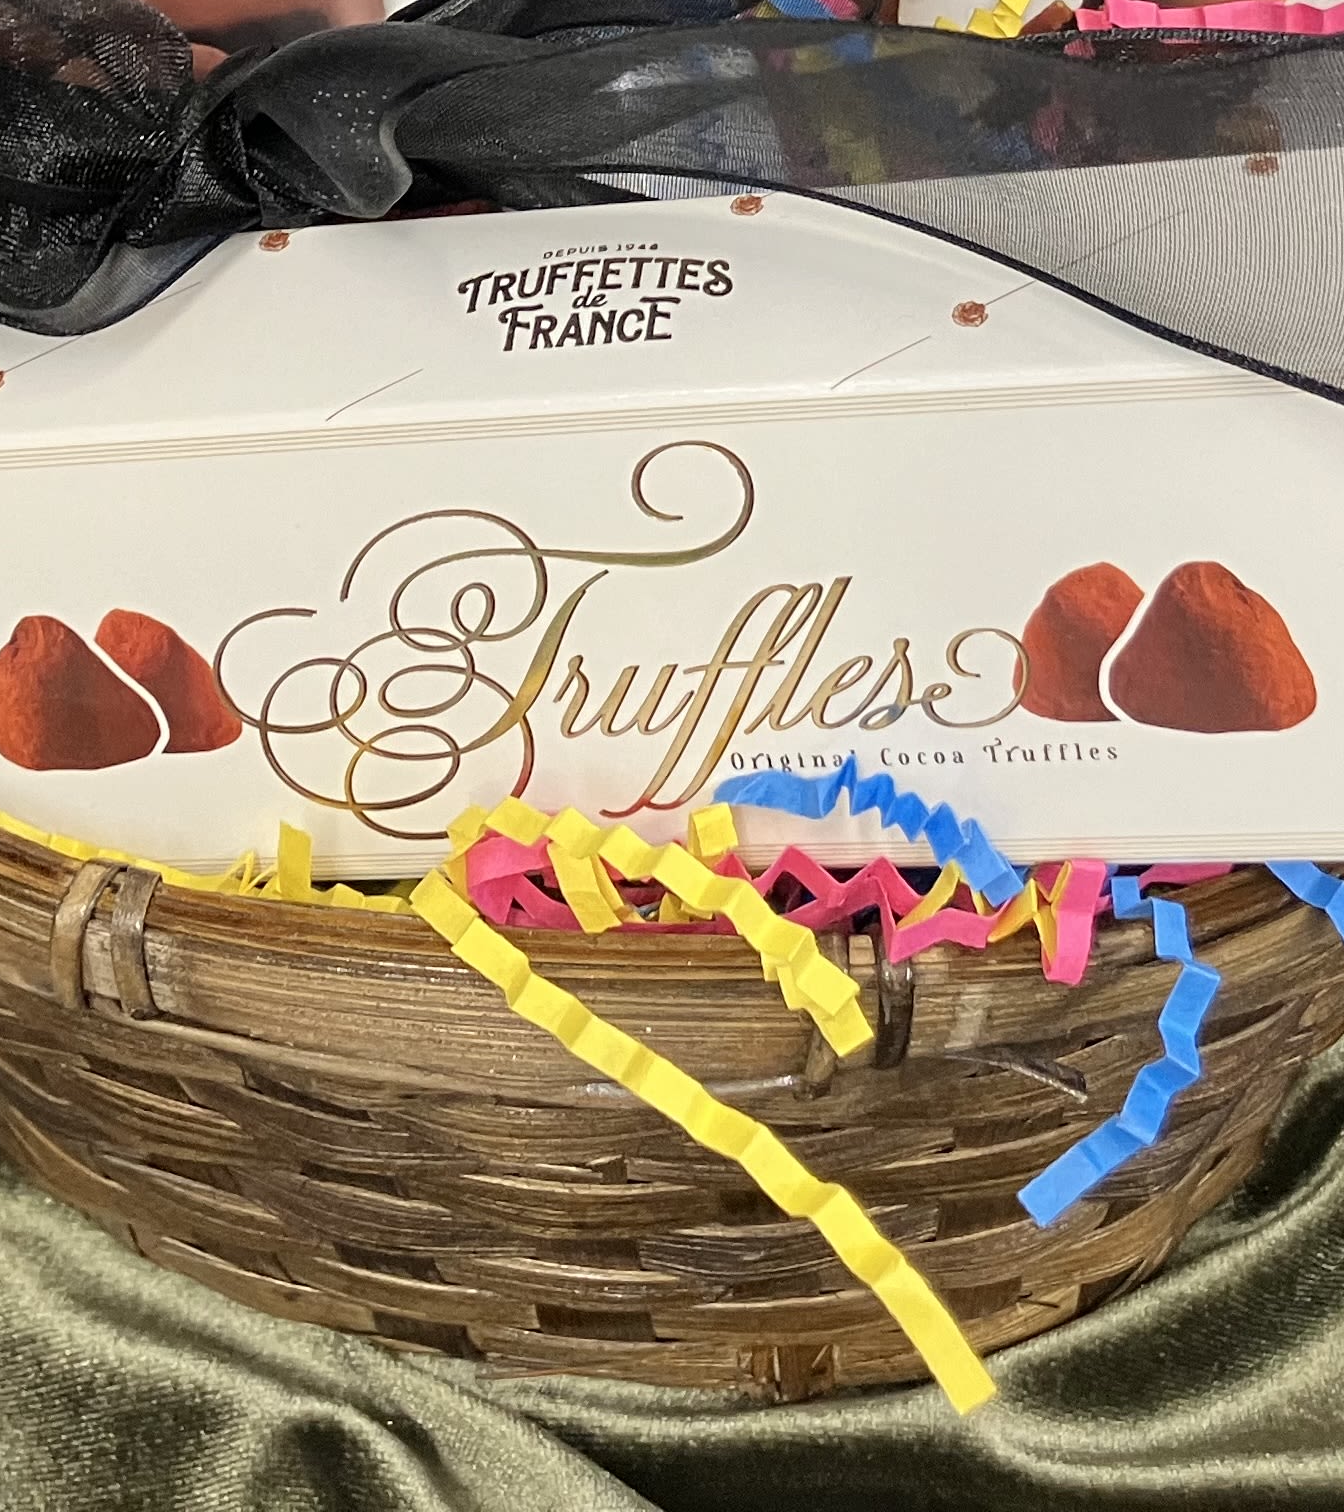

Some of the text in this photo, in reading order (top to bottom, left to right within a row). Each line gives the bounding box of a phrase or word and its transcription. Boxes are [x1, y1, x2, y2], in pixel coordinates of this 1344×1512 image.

[457, 257, 733, 313] TRUFFETTES
[572, 285, 607, 309] de
[498, 296, 680, 351] FRANCE
[214, 439, 1030, 839] Truffles
[730, 737, 1119, 772] Origina Cocoa Truffles
